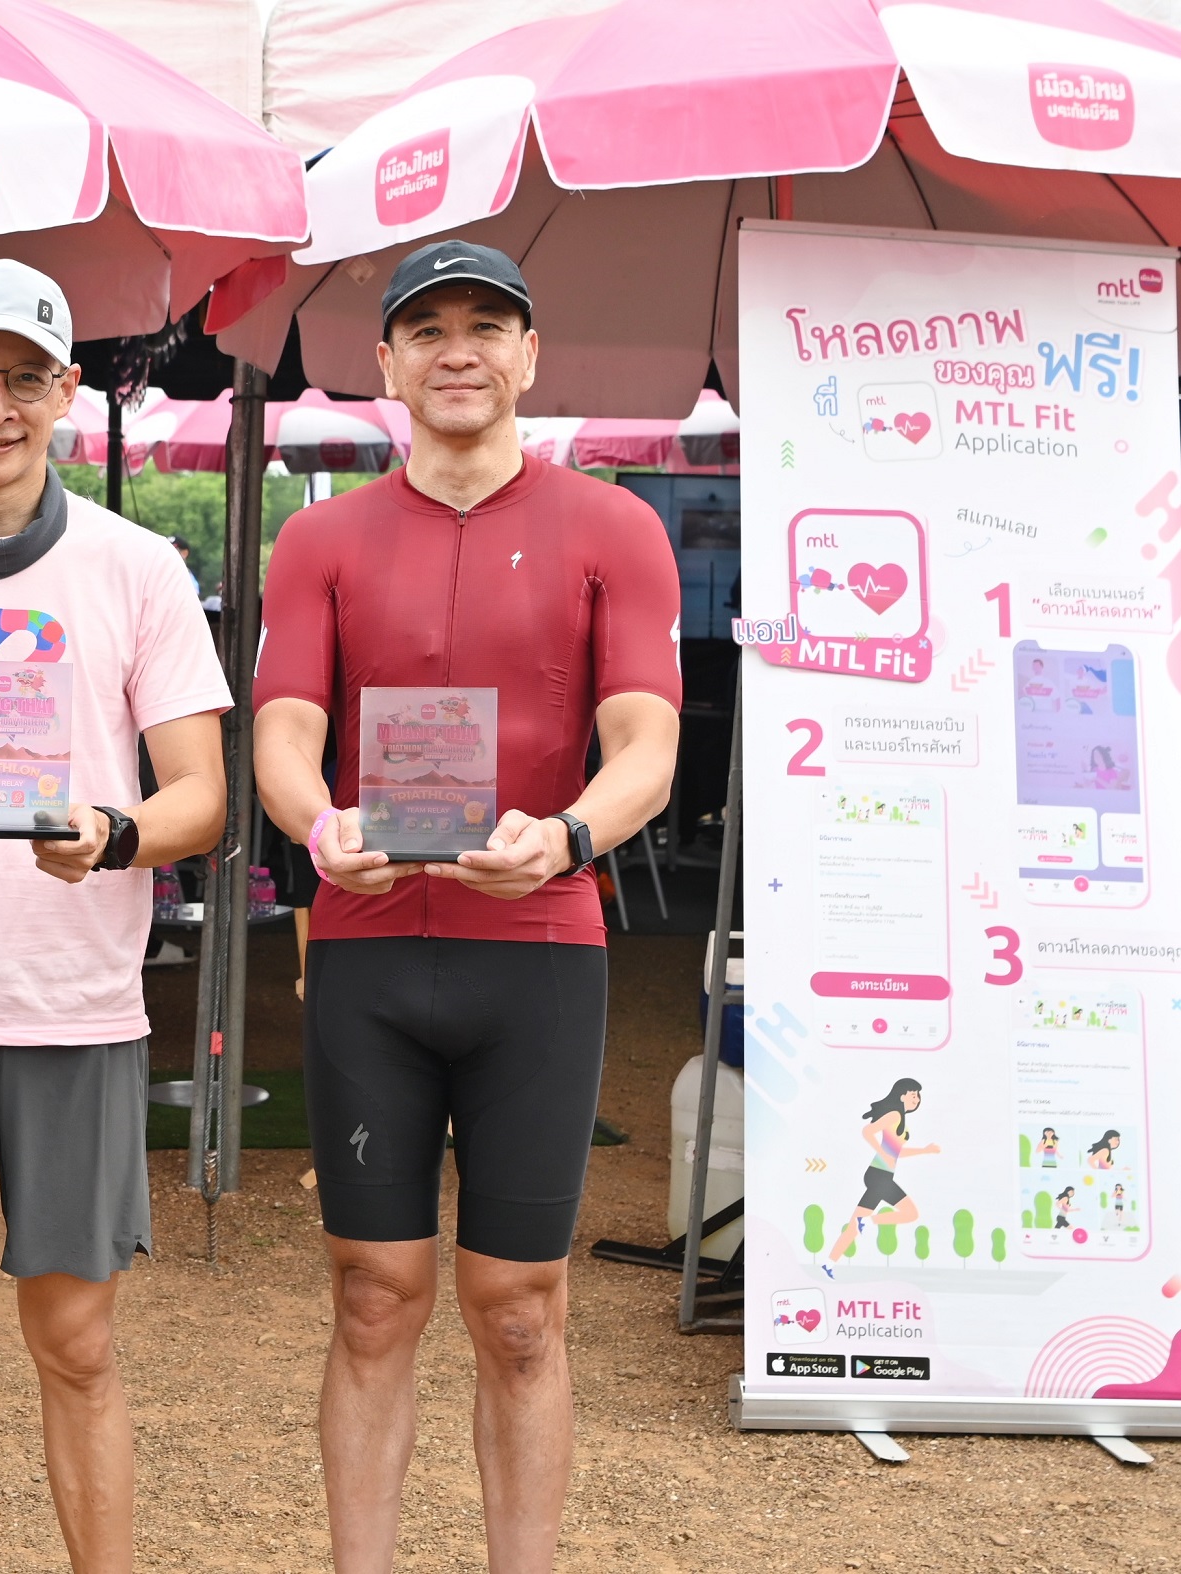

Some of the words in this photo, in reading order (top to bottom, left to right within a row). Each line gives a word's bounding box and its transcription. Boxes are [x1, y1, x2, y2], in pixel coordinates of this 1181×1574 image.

[1035, 72, 1126, 101] เมืองไทย
[380, 148, 444, 185] เมืองไทย
[1098, 278, 1141, 298] mtl
[786, 308, 1025, 362] โหลดภาพ
[935, 361, 1034, 394] ของคุณ
[955, 400, 1025, 428] MTL
[1035, 404, 1076, 432] Fit
[955, 432, 1078, 458] Application
[956, 507, 1038, 539] สแกนเลย
[806, 533, 839, 548] mtl
[984, 583, 1011, 638] 1
[798, 638, 865, 671] MTL
[875, 648, 916, 677] Fit
[785, 718, 826, 777] 2
[388, 789, 468, 805] TRIATHLON
[984, 925, 1024, 987] 3
[850, 977, 910, 993] ลงทะเบียน
[837, 1300, 886, 1319] MTL
[892, 1301, 921, 1320] Fit
[836, 1323, 923, 1339] Application
[790, 1363, 813, 1375] App
[814, 1363, 839, 1374] Store
[874, 1366, 906, 1378] Google
[906, 1367, 925, 1378] Play
